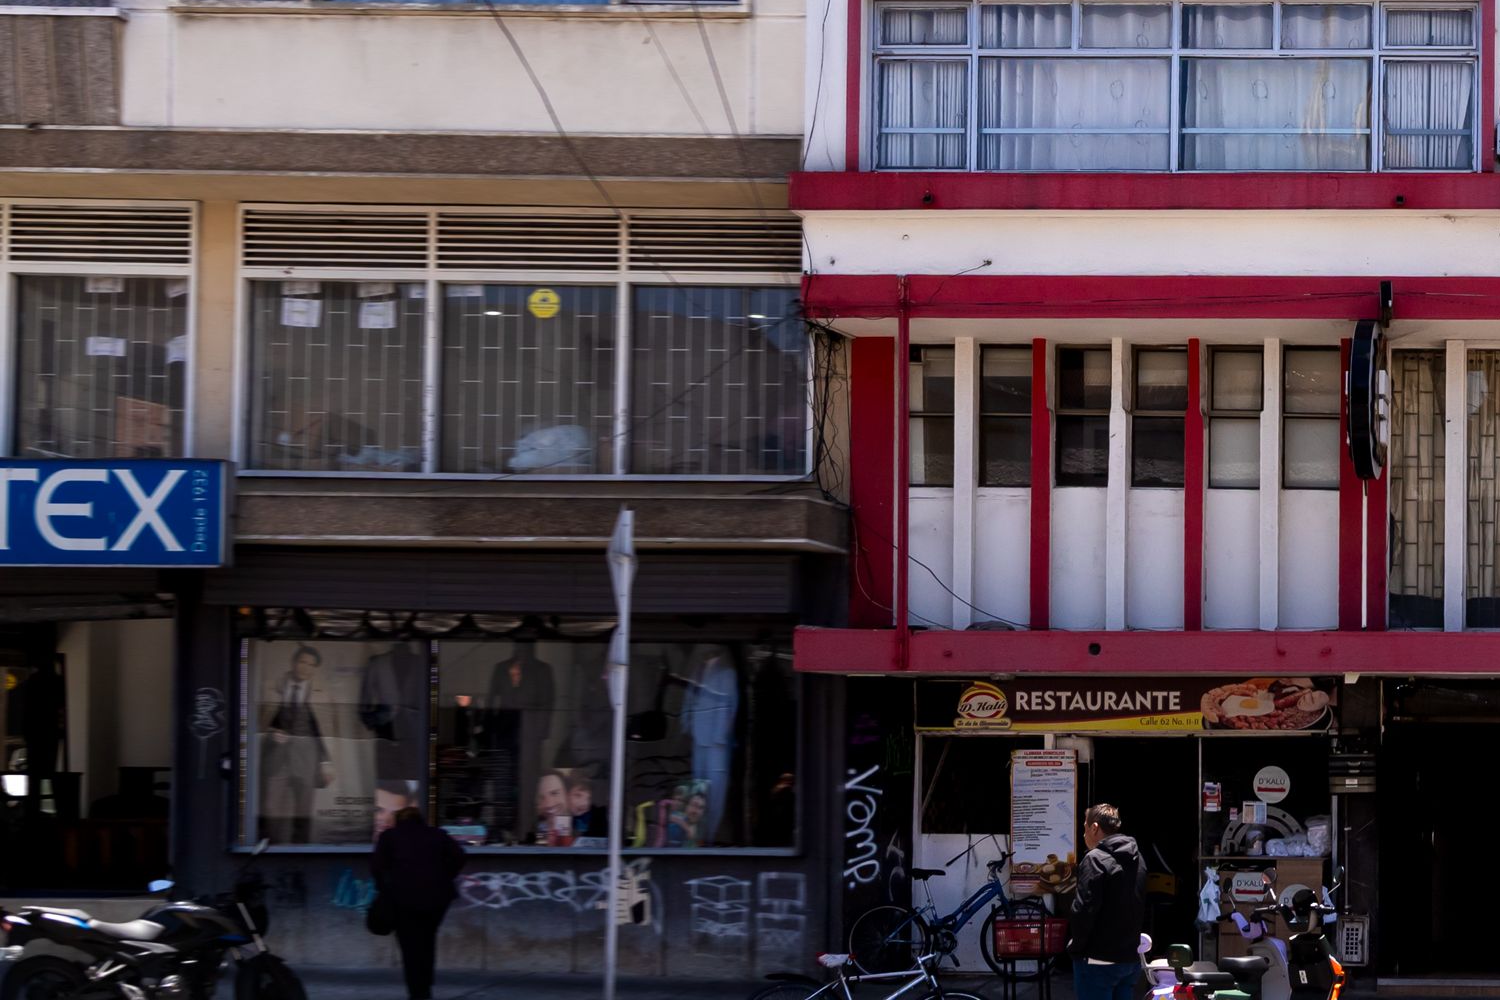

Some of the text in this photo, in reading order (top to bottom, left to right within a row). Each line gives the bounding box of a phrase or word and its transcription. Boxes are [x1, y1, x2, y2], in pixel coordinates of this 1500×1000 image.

[191, 469, 208, 552] Desde 1932
[1016, 691, 1180, 711] RESTAURANTE
[1140, 716, 1158, 726] Calle
[1160, 717, 1170, 726] 62
[1172, 717, 1184, 726] No.
